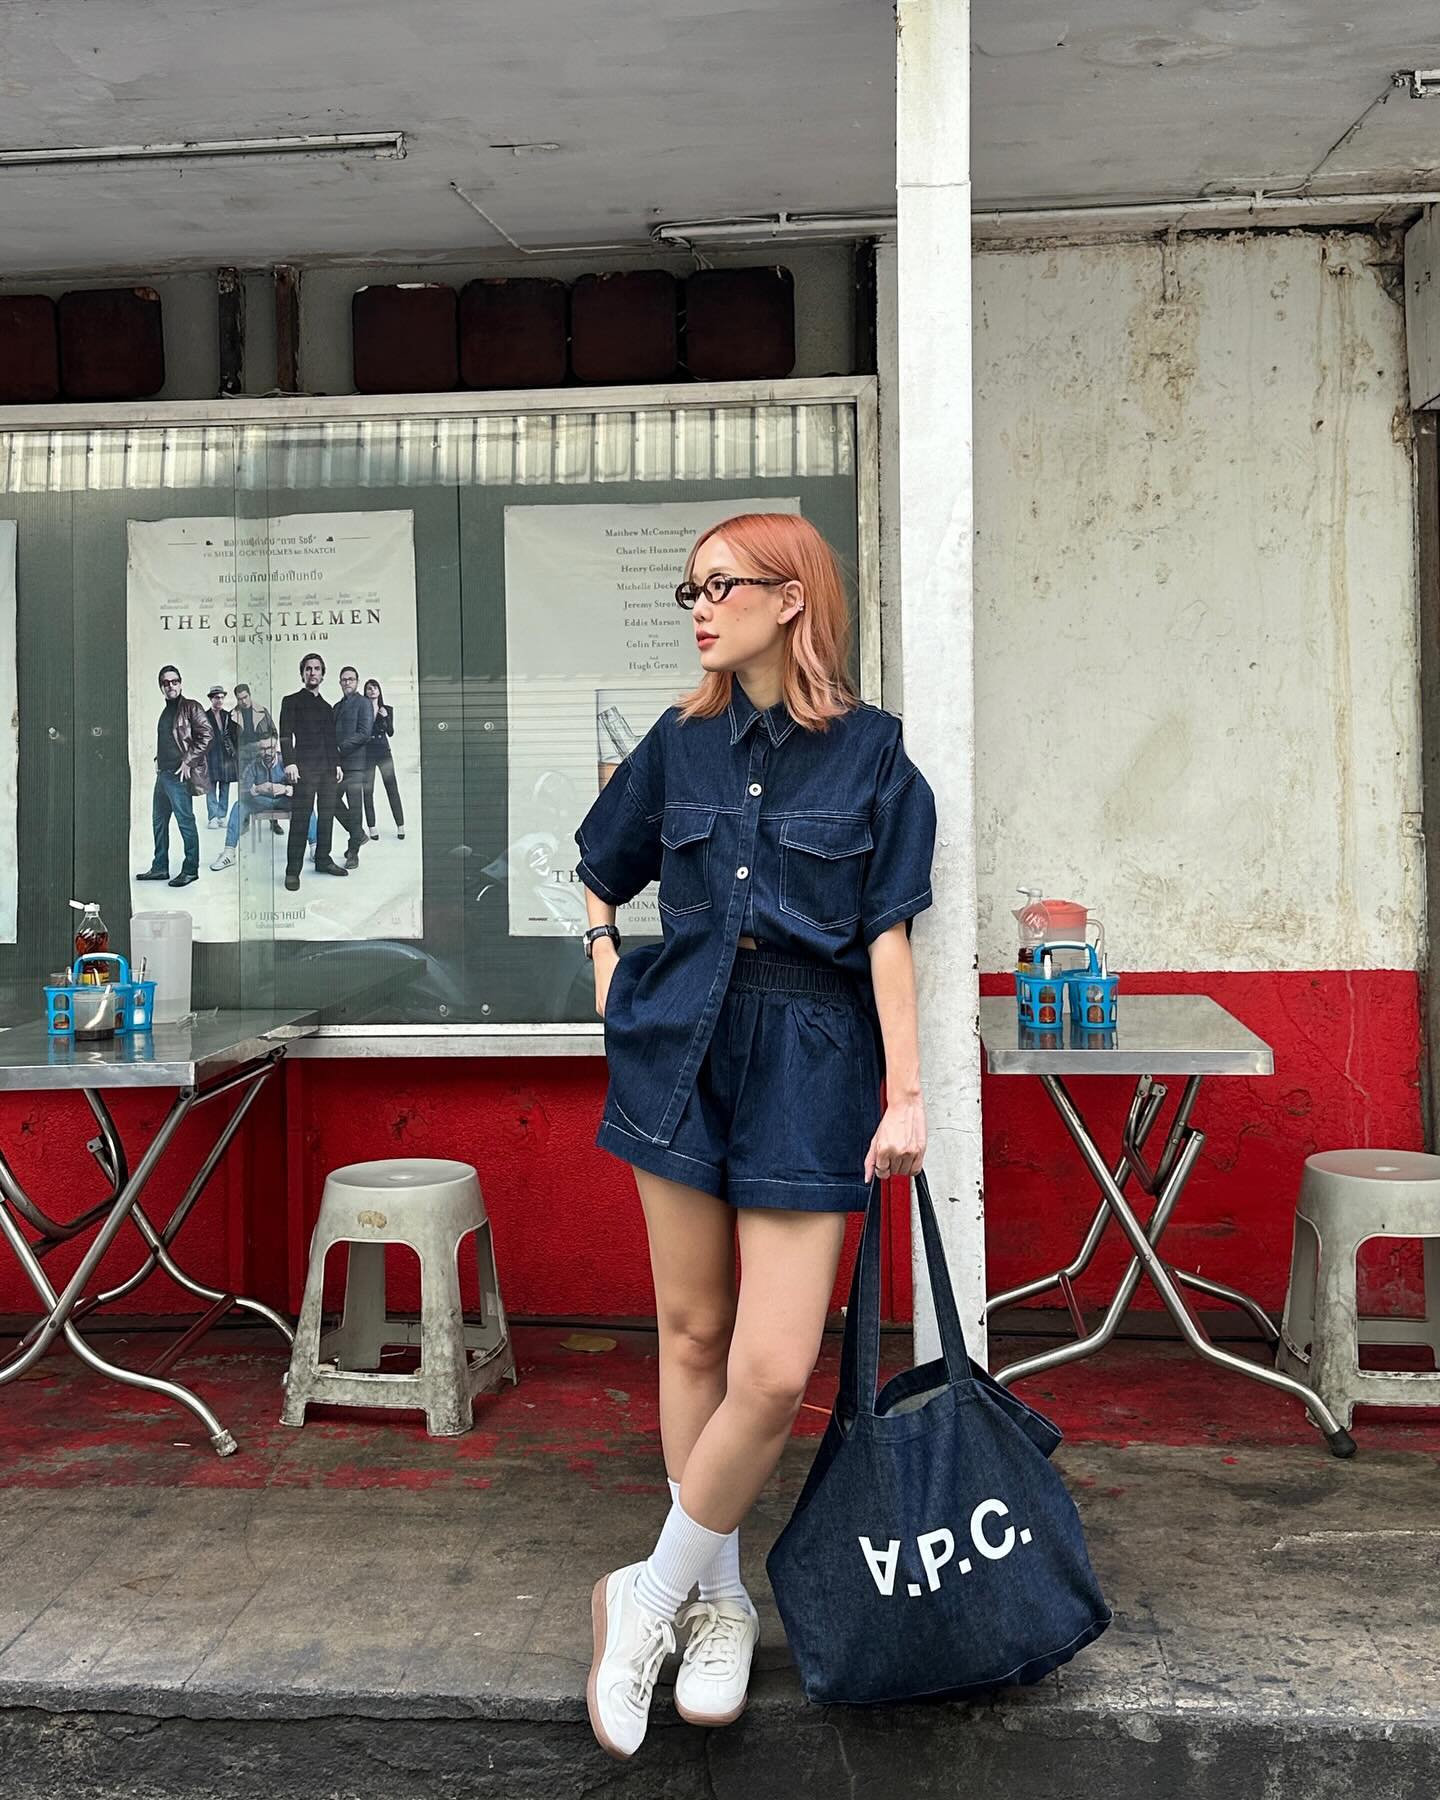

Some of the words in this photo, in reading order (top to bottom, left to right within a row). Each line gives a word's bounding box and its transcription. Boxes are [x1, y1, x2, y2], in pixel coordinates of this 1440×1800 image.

[605, 529, 638, 537] Matthew
[640, 527, 697, 537] McConaughey
[214, 549, 257, 557] SHEROCK
[304, 547, 336, 555] SNATCH
[616, 546, 647, 555] Charlie
[649, 546, 687, 554] Hunnam
[621, 564, 647, 573] Henry
[648, 563, 683, 573] Golding
[616, 583, 651, 591] Michelle
[653, 582, 677, 590] Docke
[623, 600, 652, 609] Jeremy
[160, 614, 211, 630] THE
[224, 609, 381, 629] GENTLEMEN
[624, 619, 648, 627] Eddie
[626, 640, 650, 648] Colin
[651, 639, 680, 648] Farrell
[629, 661, 651, 671] Hugh
[653, 661, 678, 669] Grant
[551, 870, 583, 883] TH
[618, 901, 656, 910] IMINA
[243, 911, 257, 921] 30
